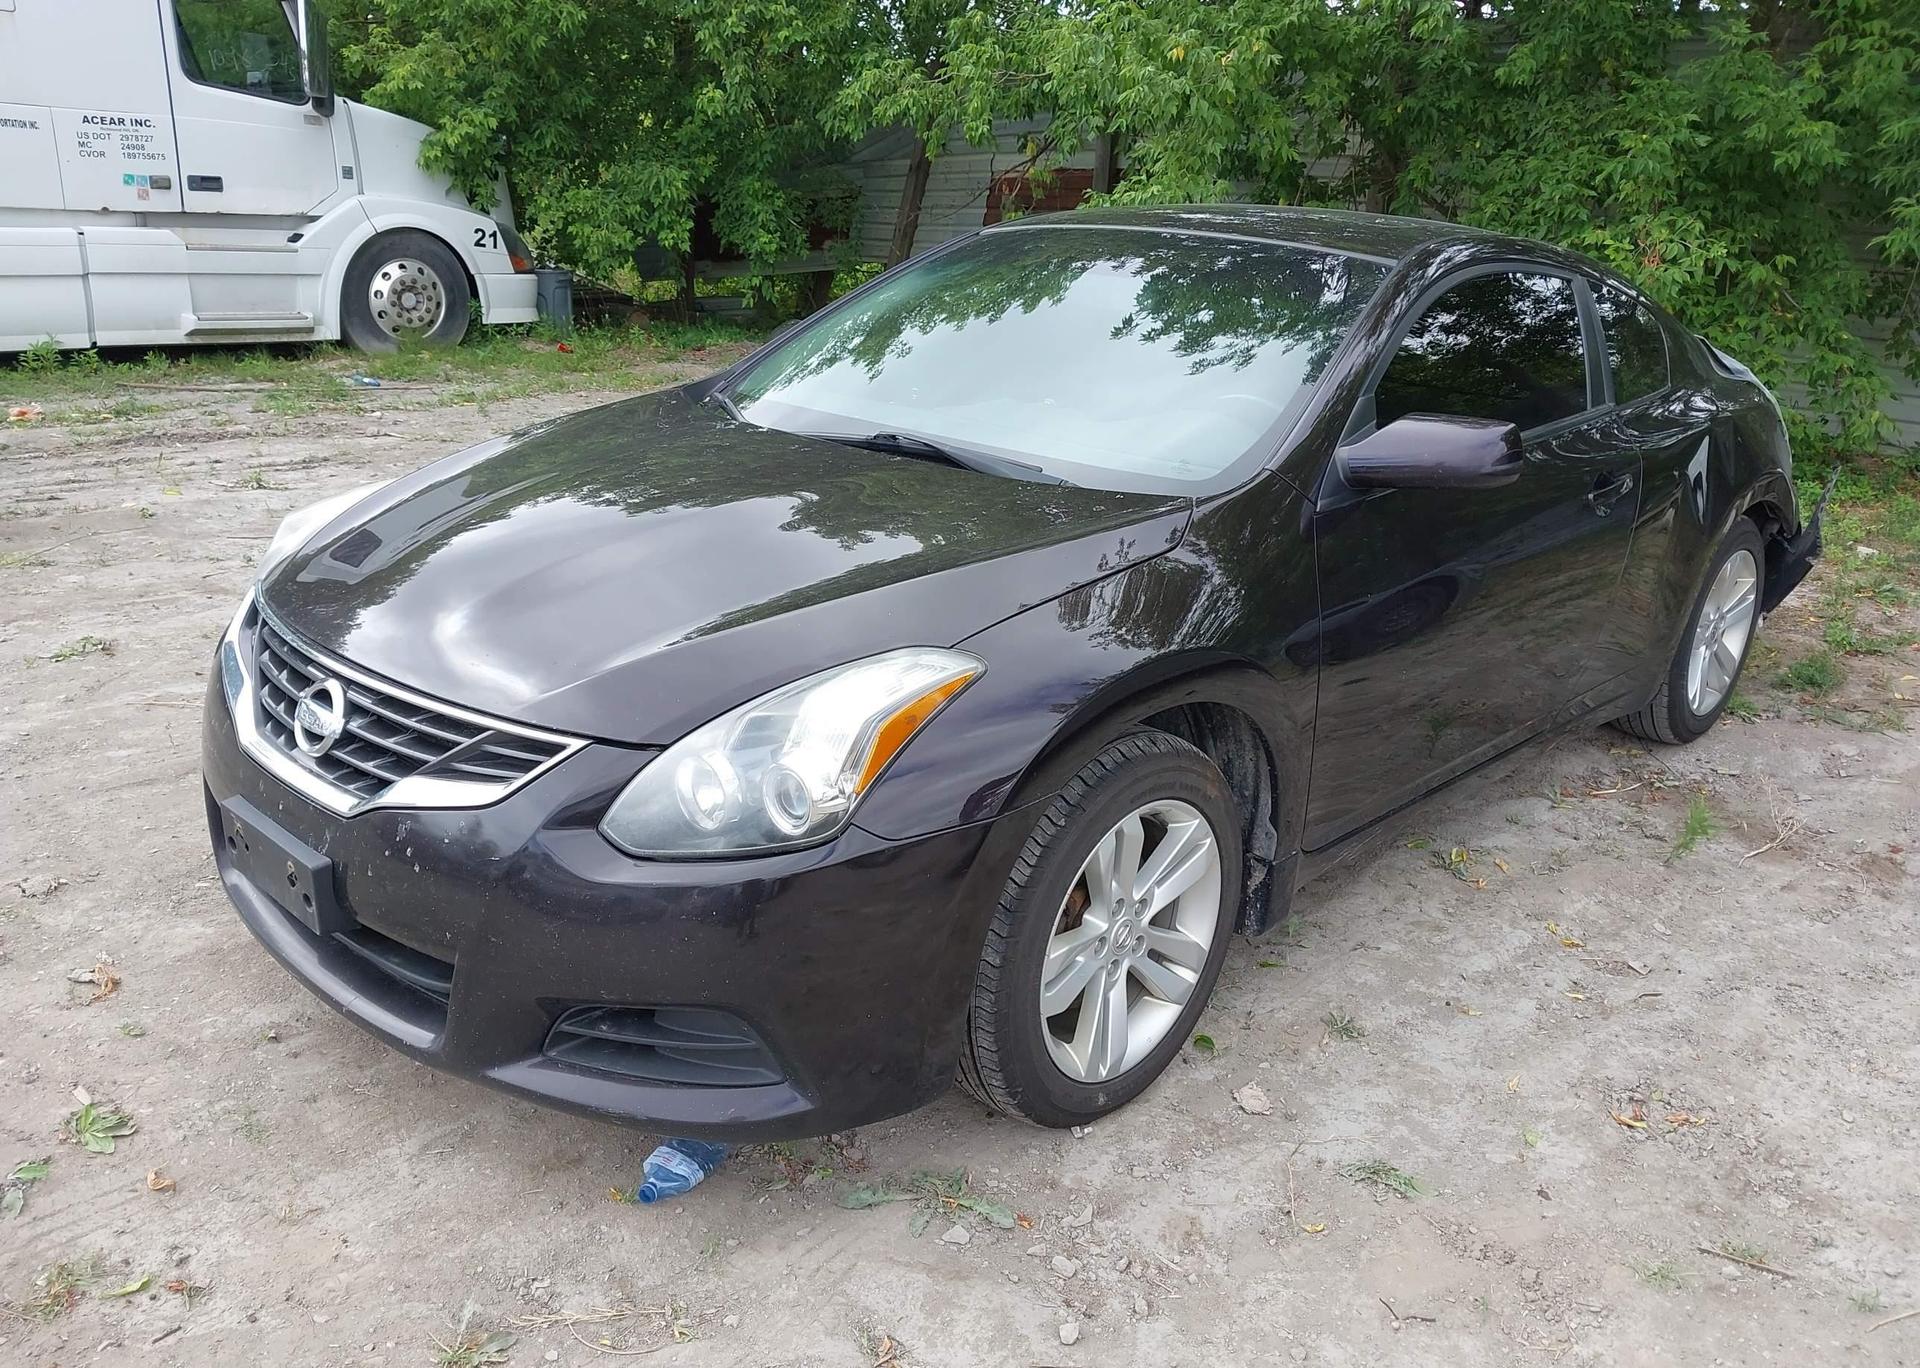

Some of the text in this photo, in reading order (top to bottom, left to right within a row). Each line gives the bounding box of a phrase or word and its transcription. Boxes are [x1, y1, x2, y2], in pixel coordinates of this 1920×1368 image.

[0, 118, 28, 129] ORTATION
[82, 115, 156, 128] ACEAR INC.
[76, 131, 154, 143] US DOT 2978727
[78, 141, 146, 151] MC 24908
[79, 150, 106, 158] CVOR
[473, 228, 498, 249] 21
